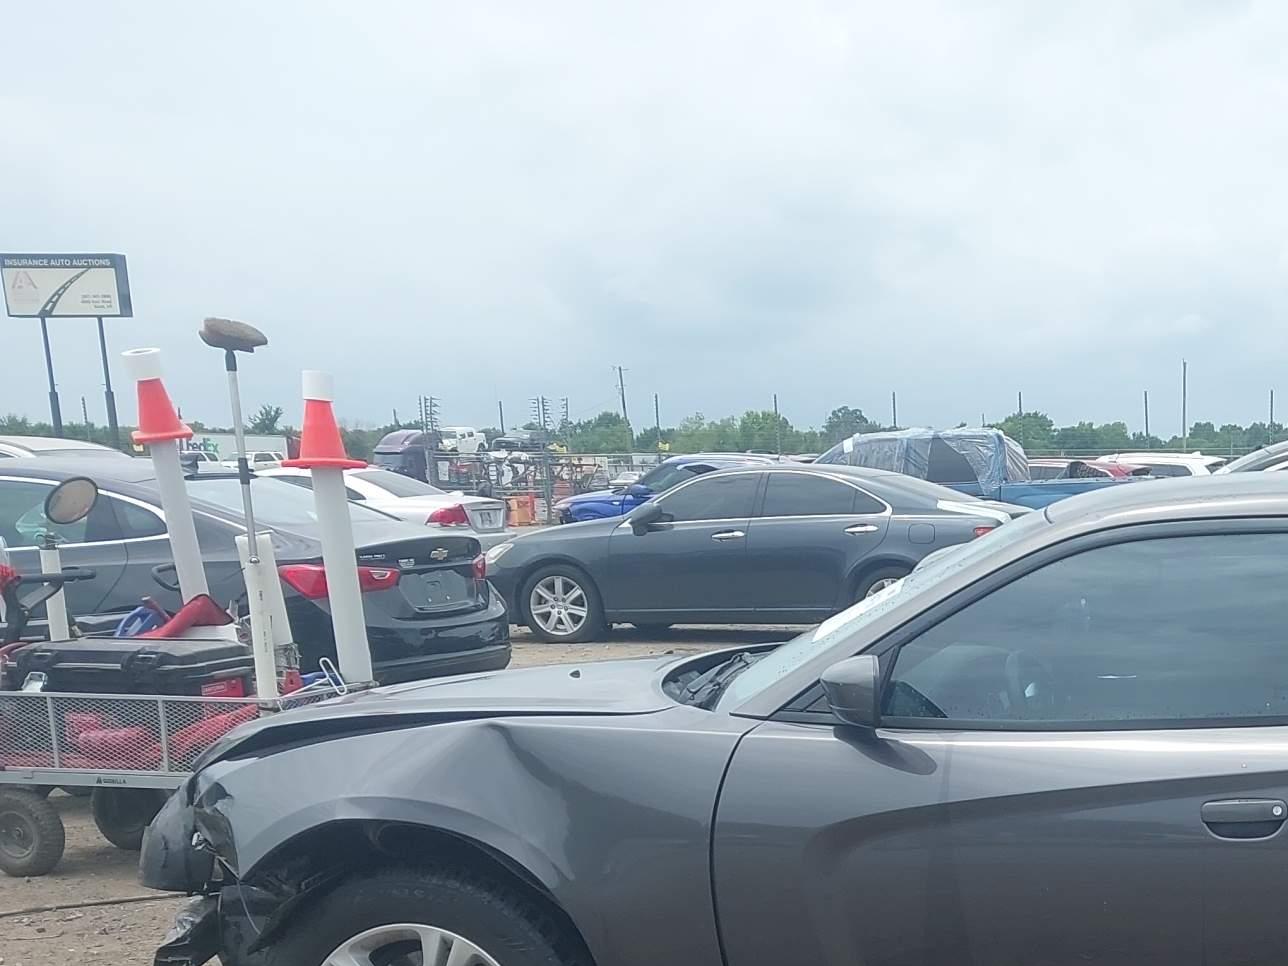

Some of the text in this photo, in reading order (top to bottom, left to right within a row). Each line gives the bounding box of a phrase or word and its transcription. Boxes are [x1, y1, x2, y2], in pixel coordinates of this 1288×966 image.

[4, 258, 111, 266] INSURANCE AUTO AUCTIONS
